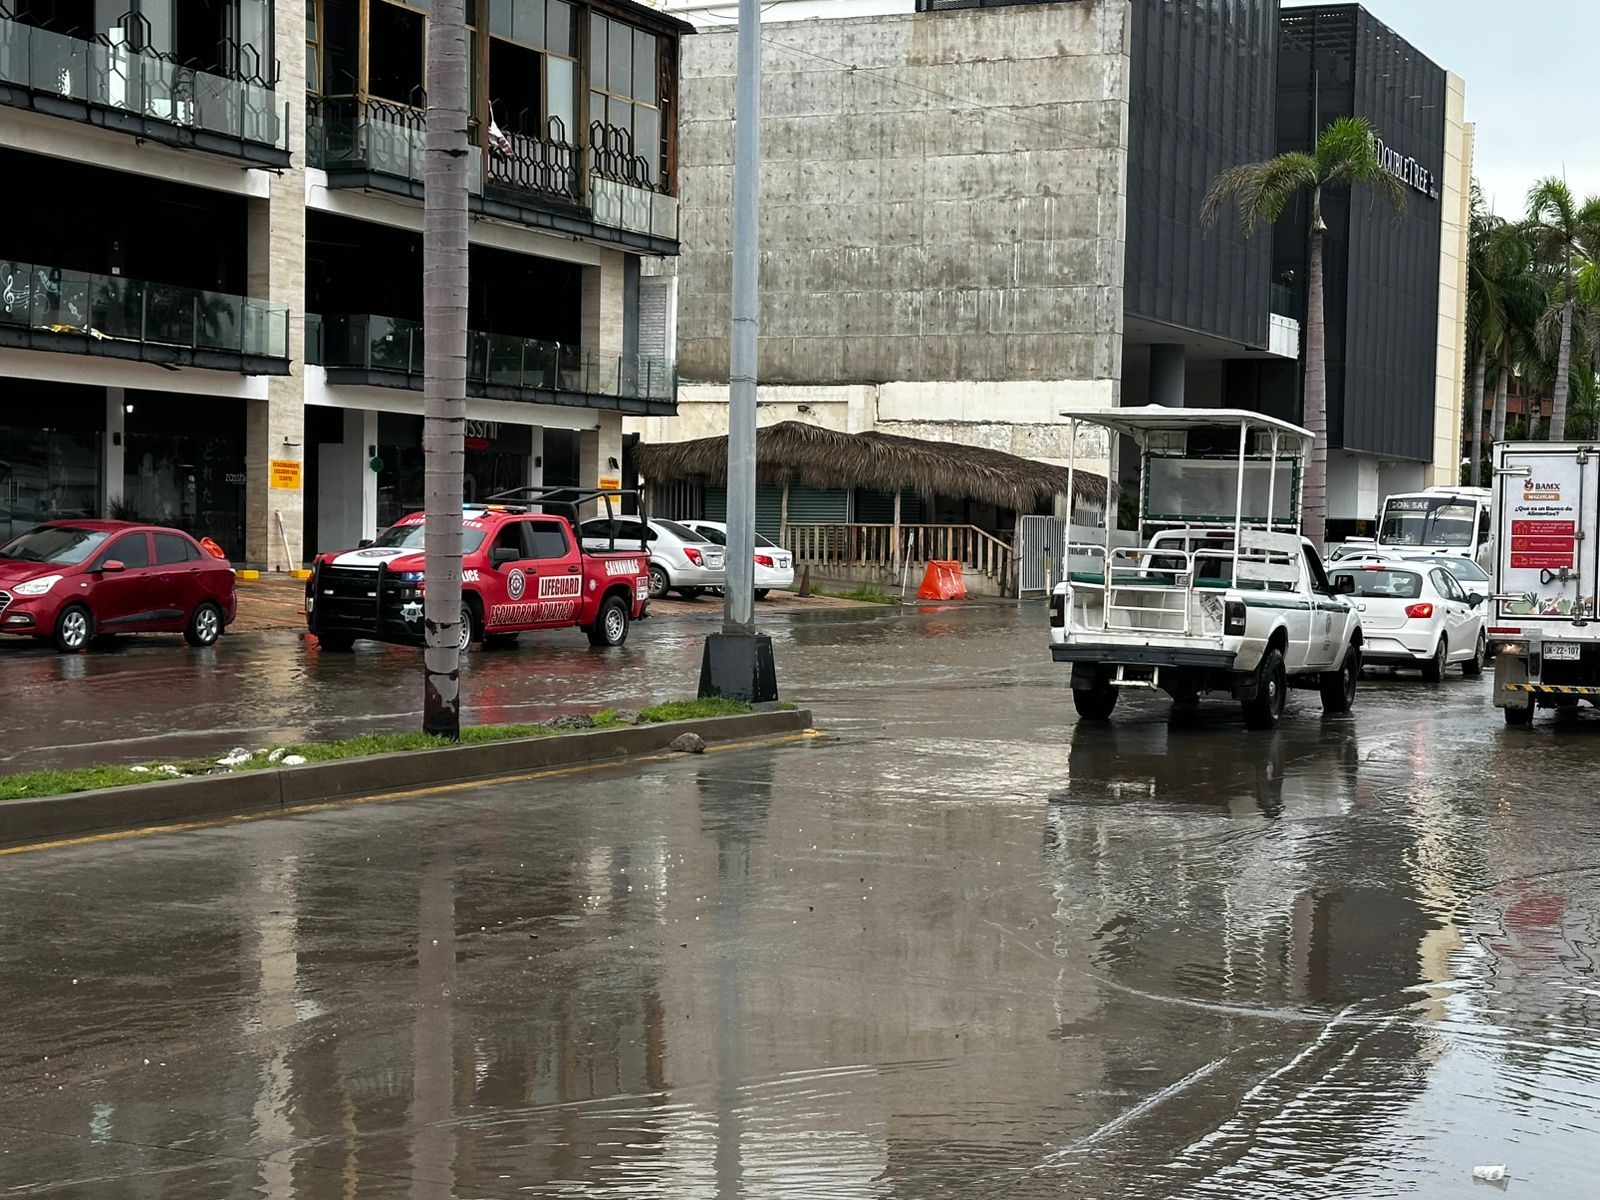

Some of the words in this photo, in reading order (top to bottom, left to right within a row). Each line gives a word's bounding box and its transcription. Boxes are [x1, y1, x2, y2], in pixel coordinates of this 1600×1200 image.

[225, 471, 246, 482] zassh
[462, 569, 480, 582] LICE
[541, 576, 579, 596] LIFEGUARD
[487, 603, 538, 626] ESCUADRON
